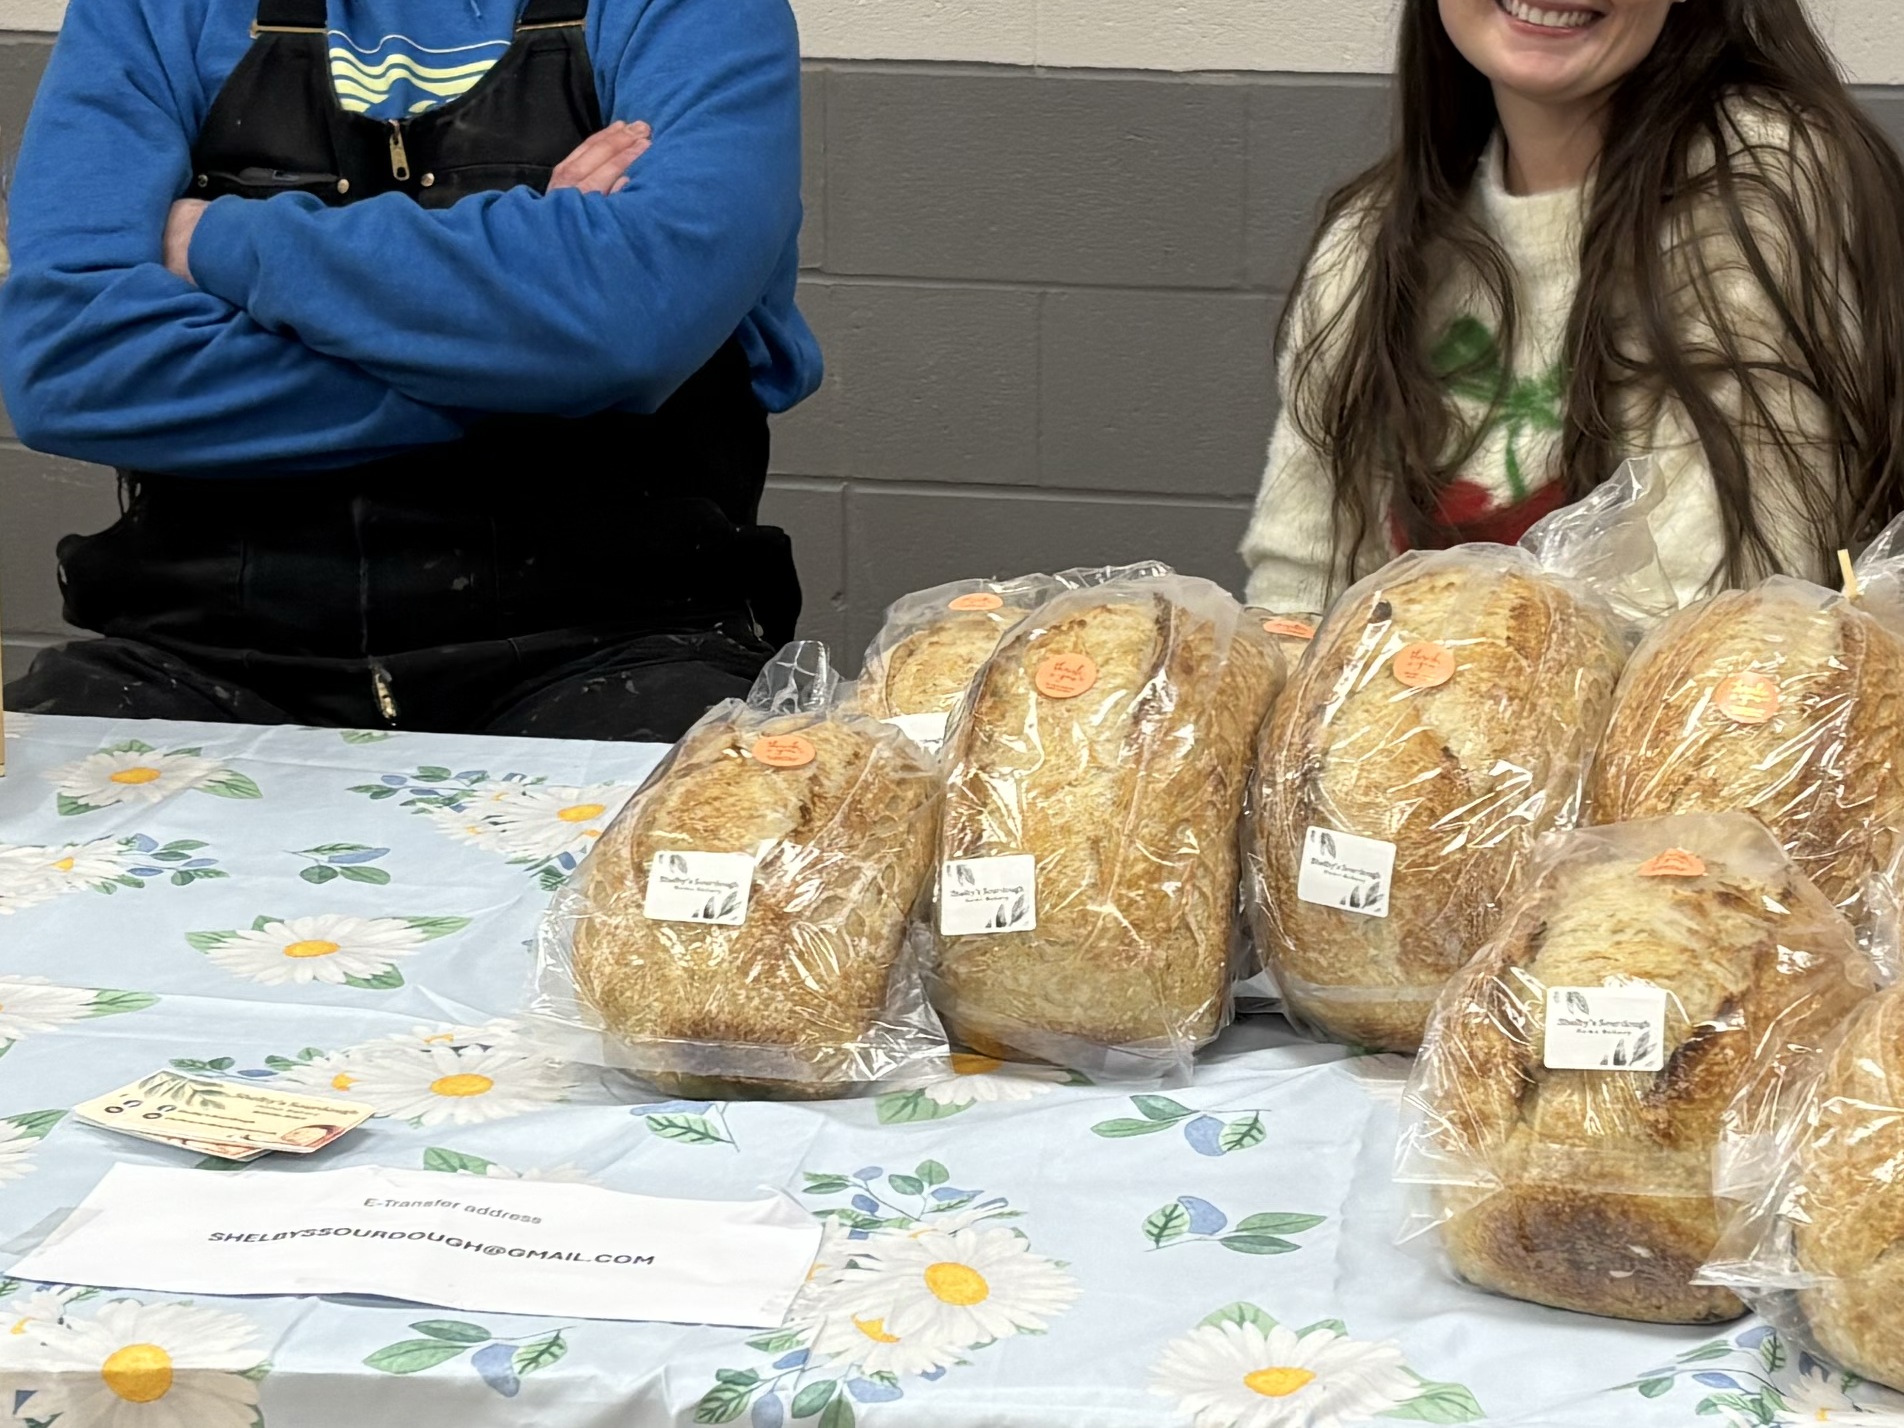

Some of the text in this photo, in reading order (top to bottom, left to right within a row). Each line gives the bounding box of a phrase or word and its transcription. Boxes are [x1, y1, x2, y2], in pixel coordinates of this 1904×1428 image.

[363, 1197, 542, 1224] E-Transfer address
[207, 1226, 656, 1266] SHELBYSSOURDOUGH@GMAIL.COM
